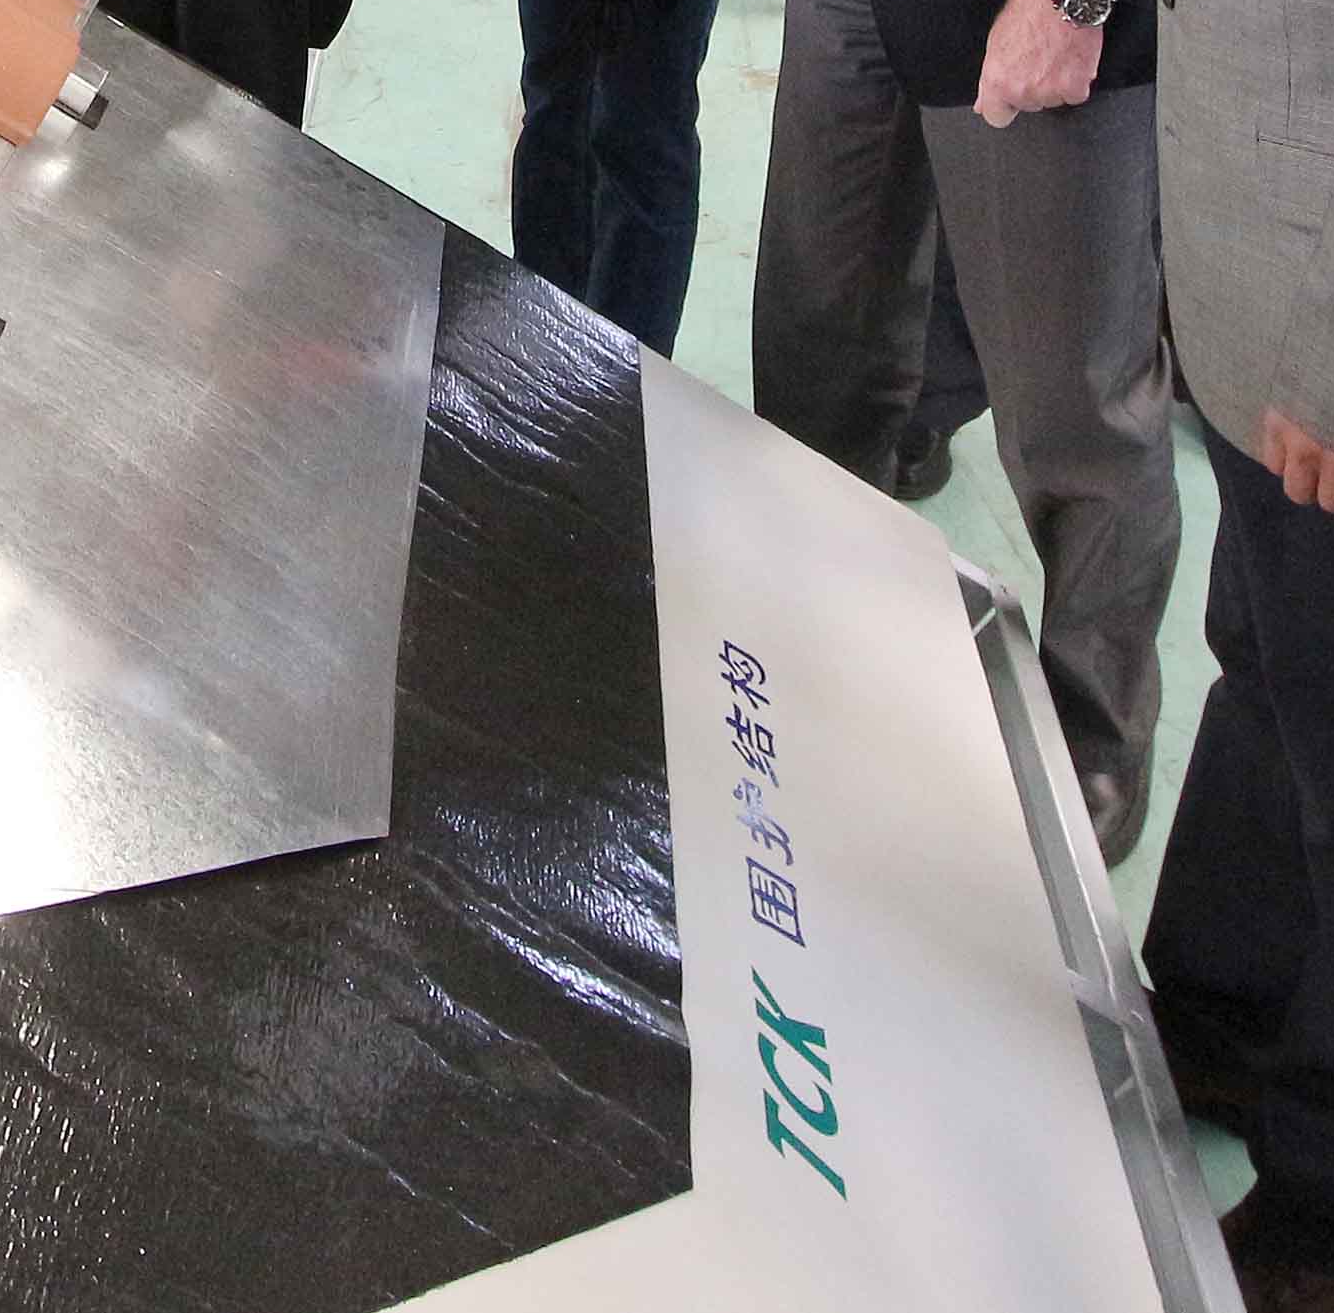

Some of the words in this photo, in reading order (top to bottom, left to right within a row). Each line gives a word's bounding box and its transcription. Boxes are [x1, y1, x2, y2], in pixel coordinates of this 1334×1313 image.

[718, 639, 806, 948] 围护结构
[752, 966, 847, 1202] TCK
